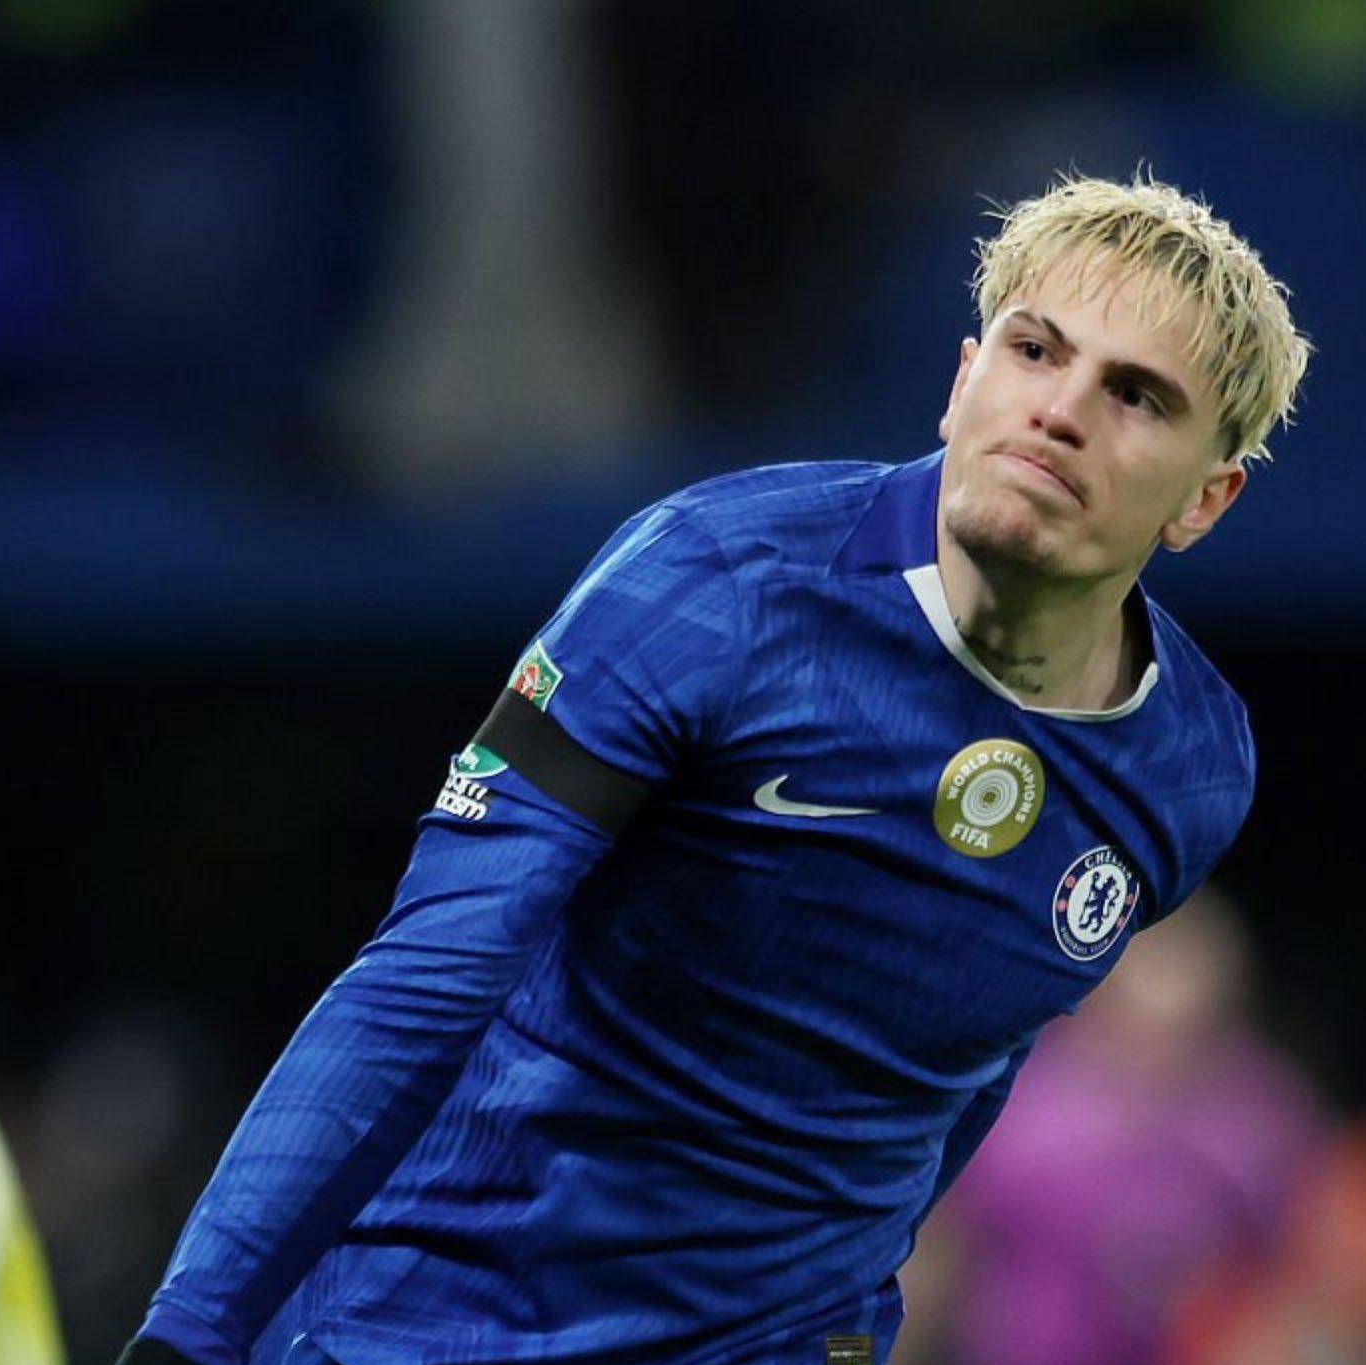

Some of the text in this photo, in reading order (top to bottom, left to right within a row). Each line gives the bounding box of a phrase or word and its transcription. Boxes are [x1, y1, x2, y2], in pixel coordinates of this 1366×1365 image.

[947, 749, 1036, 824] WORLD CHAMPIONS
[949, 823, 989, 851] FIFA
